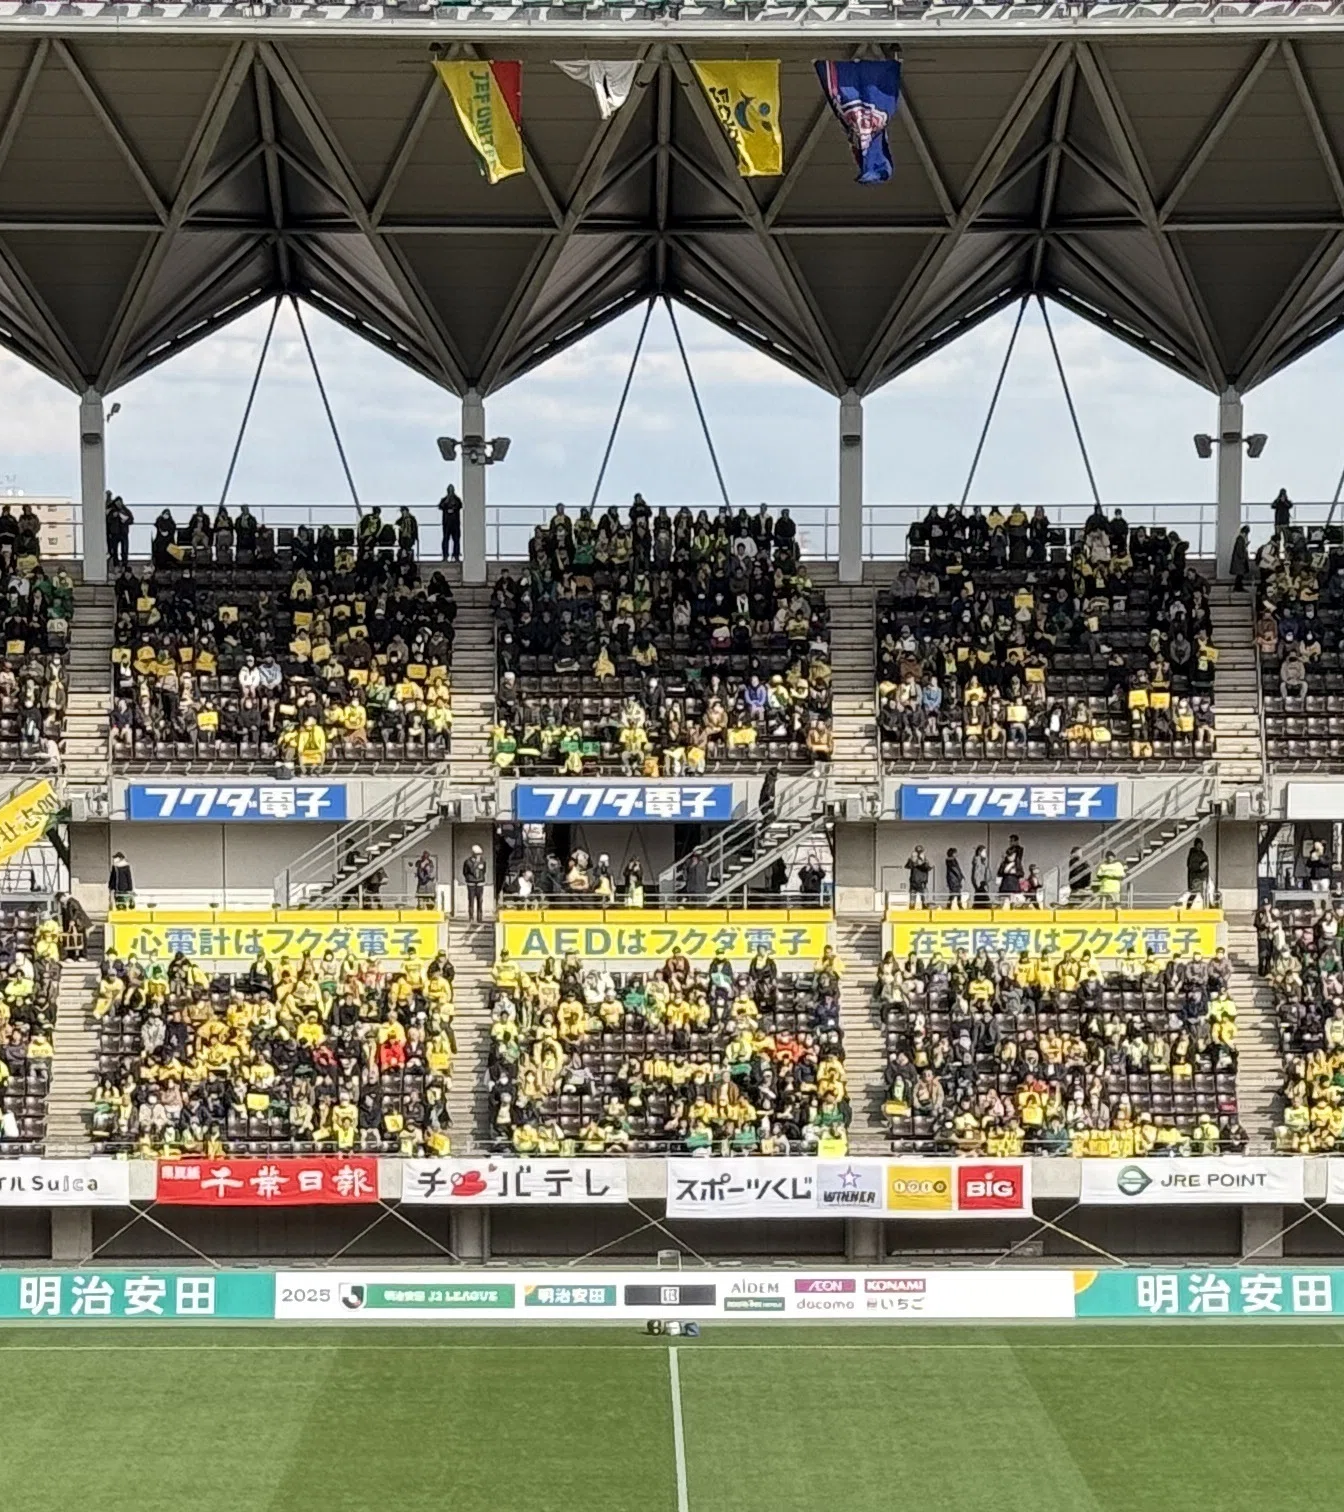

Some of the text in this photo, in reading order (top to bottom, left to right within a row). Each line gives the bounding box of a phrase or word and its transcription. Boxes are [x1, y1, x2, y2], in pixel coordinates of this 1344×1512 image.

[144, 786, 332, 818] フクダ電子
[531, 786, 717, 817] フクダ電子
[916, 785, 1103, 818] フクダ電子
[130, 926, 423, 956] 心電計はフクダ電子
[520, 926, 812, 956] AEDはフクダ電子
[908, 926, 1202, 955] 在宅医療はフクダ電子
[32, 1174, 99, 1192] Suica
[200, 1164, 374, 1200] 千葉日報
[675, 1172, 813, 1202] スポーツくじ
[1160, 1172, 1269, 1189] JRE POINT
[823, 1189, 876, 1205] WINNER
[19, 1275, 216, 1316] 明治安田
[281, 1288, 331, 1303] 2025
[537, 1287, 606, 1304] 明治安田
[866, 1280, 924, 1291] KONAMI
[1136, 1273, 1334, 1314] 明治安田
[796, 1297, 855, 1310] docomo
[880, 1297, 926, 1310] いちご
